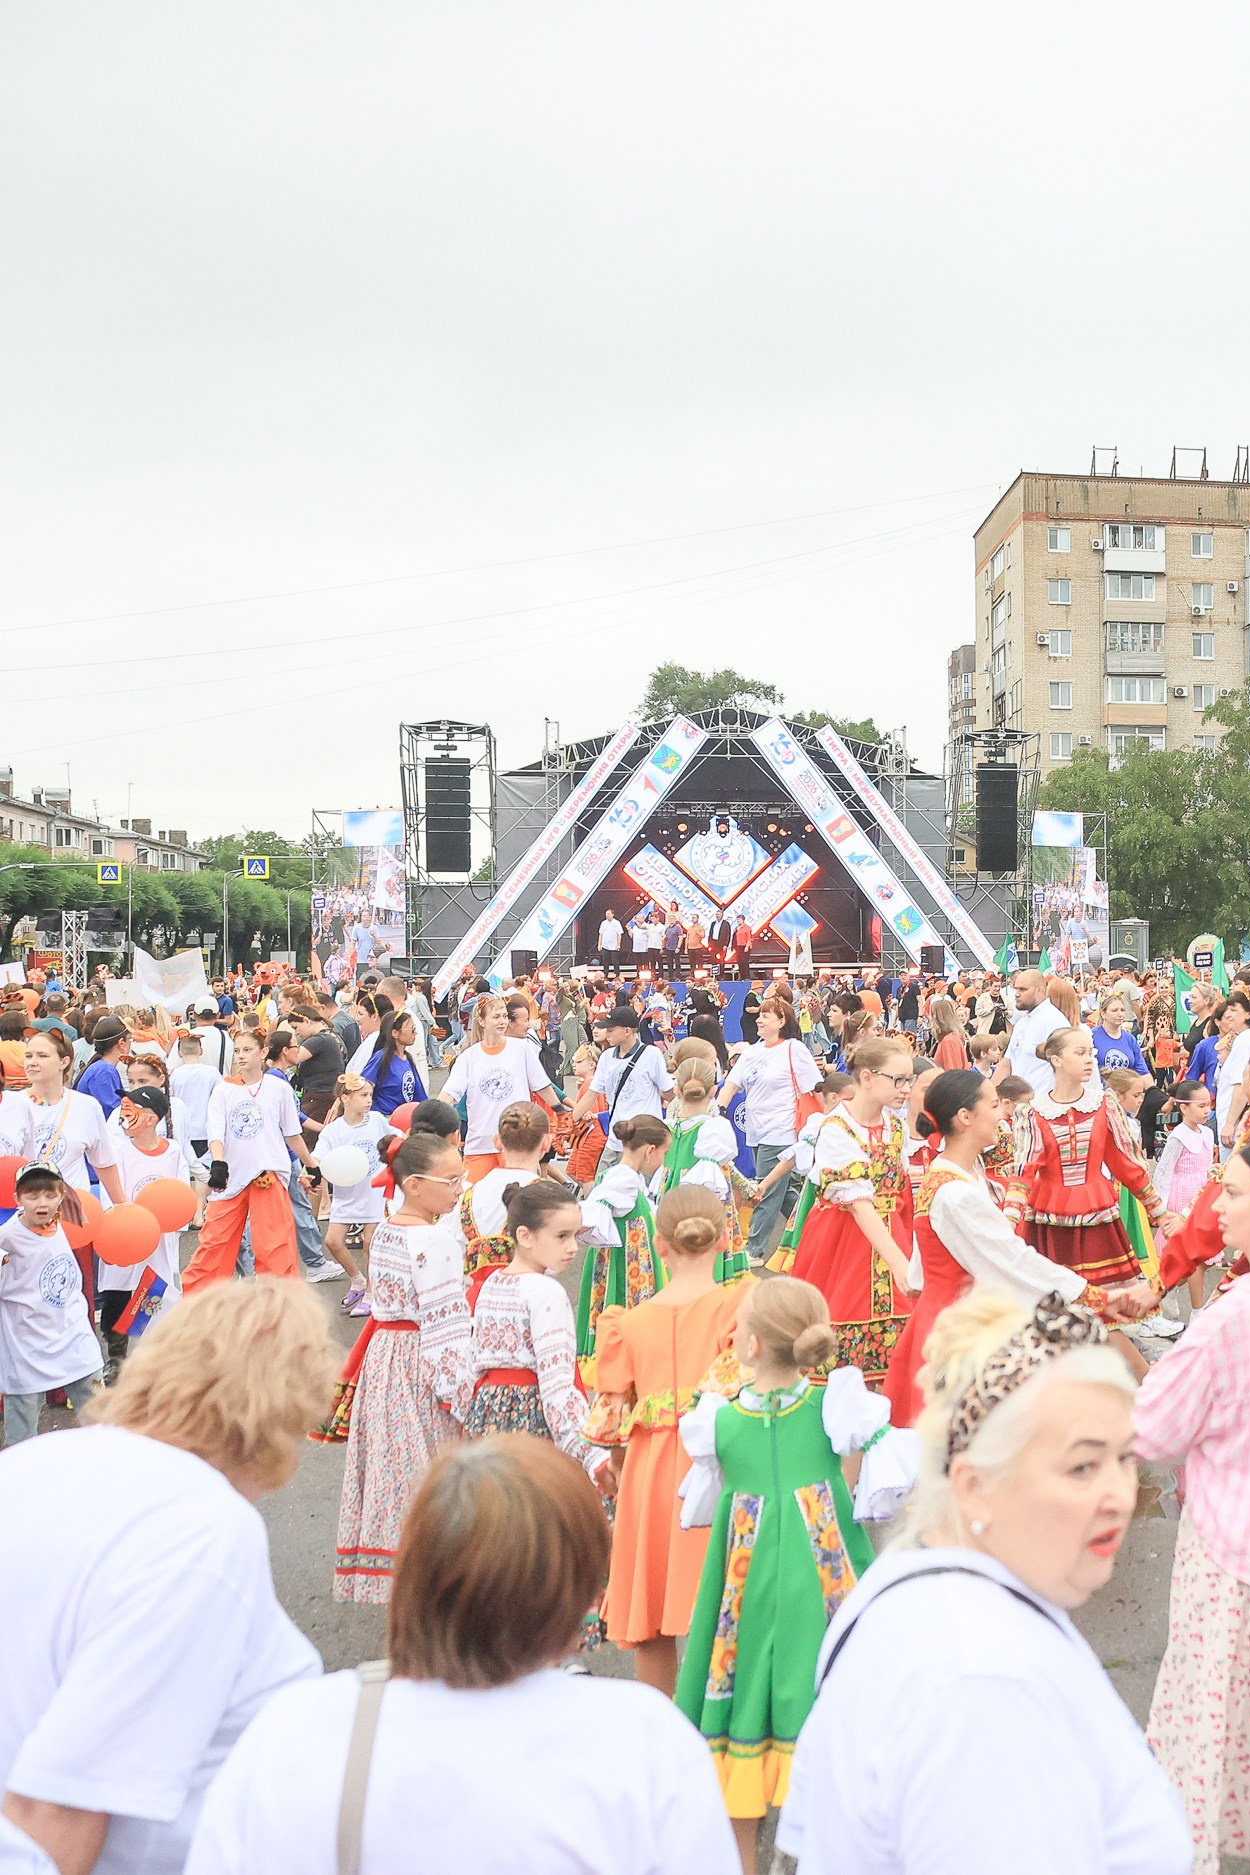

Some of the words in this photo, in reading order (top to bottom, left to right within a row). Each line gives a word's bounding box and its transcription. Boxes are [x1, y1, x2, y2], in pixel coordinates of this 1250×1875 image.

[564, 761, 610, 820] ЦЕРЕМОНИЯ
[605, 727, 634, 762] ОТКРЫ
[799, 770, 819, 794] 2026
[824, 735, 849, 766] ТИГРА
[576, 851, 597, 875] 2026
[694, 859, 734, 885] СЕМЕЙНЫЕ
[735, 860, 752, 880] ИГРЫ
[850, 771, 917, 860] МЕЖДУНАРОДНЫЙ
[913, 858, 936, 885] ДЕНЬ
[933, 884, 957, 913] ТИГРА
[452, 898, 506, 968] УССУРИЙСКИХ
[503, 844, 547, 900] СЕМЕЙНЫХ
[544, 825, 561, 845] ИГР
[644, 851, 716, 919] ЦЕРЕМОНИЯ
[747, 886, 786, 924] ЕЙНЫХ
[788, 861, 808, 888] ИГР
